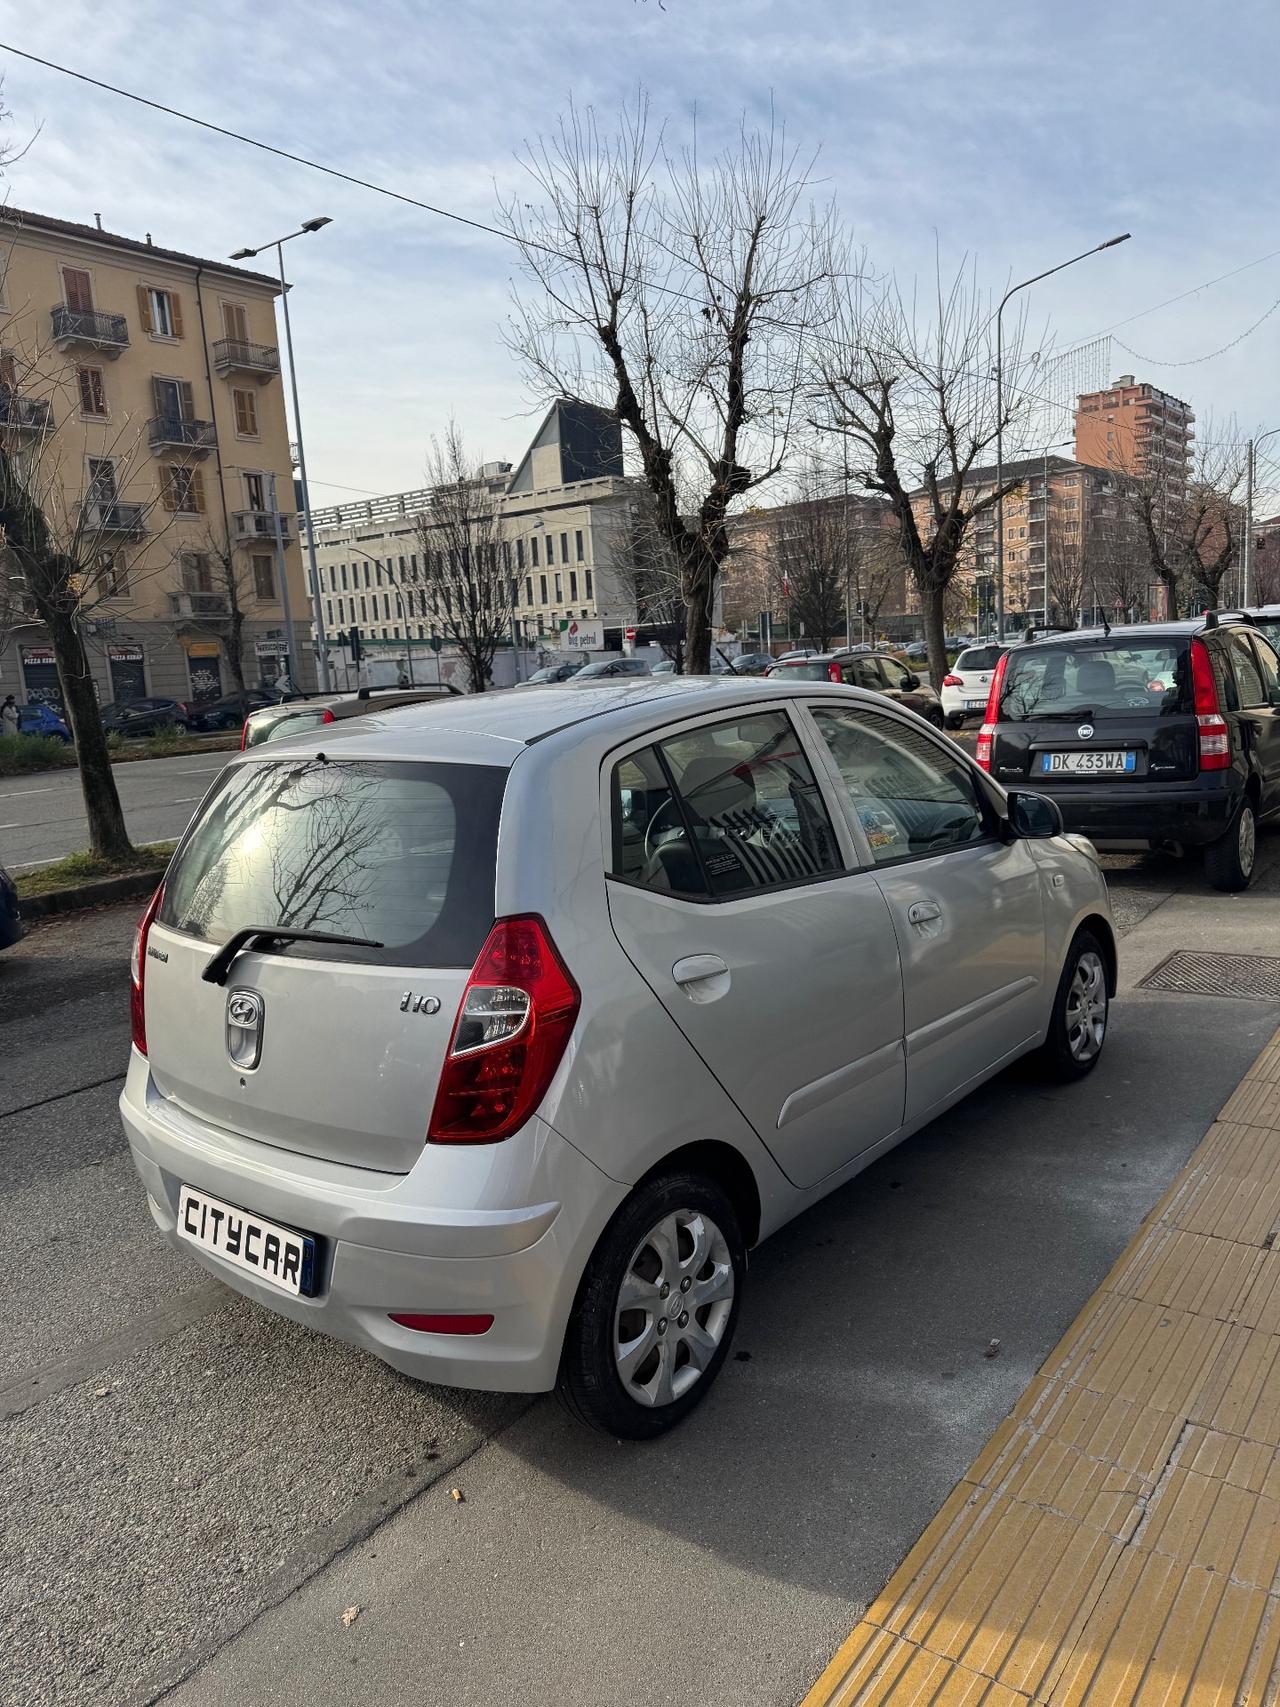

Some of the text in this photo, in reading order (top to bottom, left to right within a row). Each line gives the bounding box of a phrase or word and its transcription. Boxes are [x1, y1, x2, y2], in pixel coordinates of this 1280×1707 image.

[580, 632, 596, 647] petrol
[1053, 754, 1070, 769] DK
[1076, 752, 1124, 769] 433WA
[184, 1197, 300, 1286] CITYCAR
